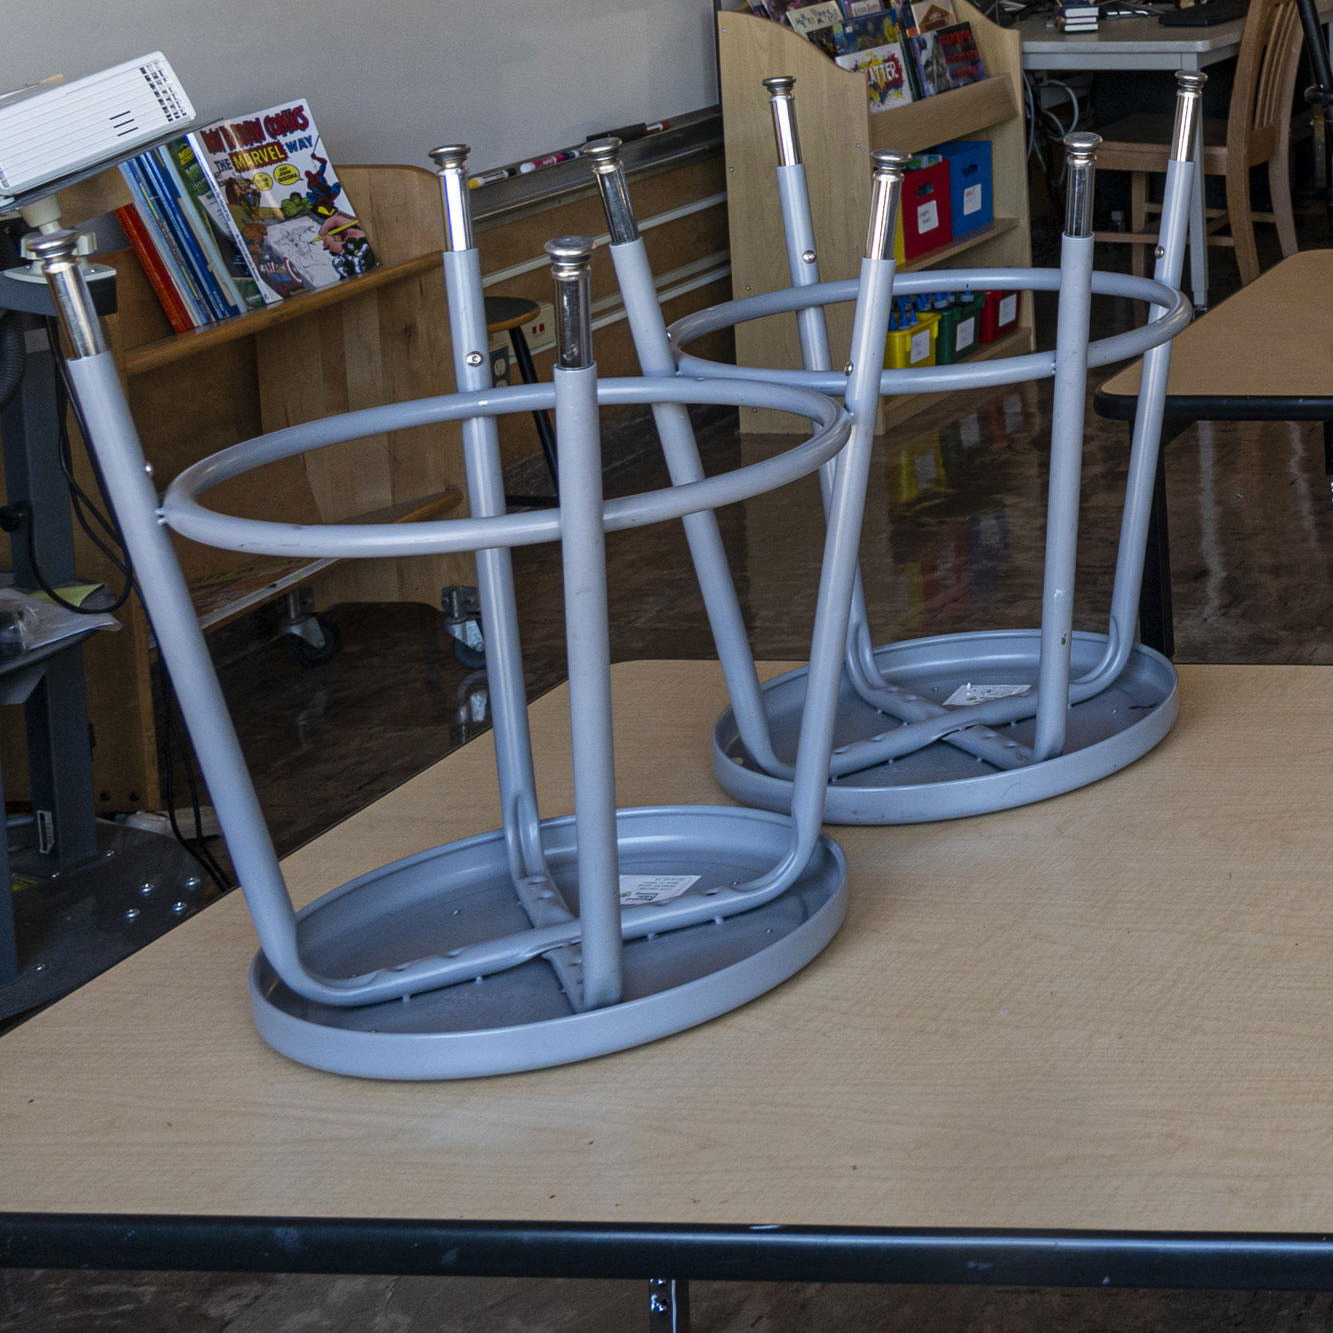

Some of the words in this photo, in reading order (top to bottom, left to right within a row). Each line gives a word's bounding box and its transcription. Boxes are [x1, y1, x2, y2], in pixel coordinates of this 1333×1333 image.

[263, 105, 309, 140] COMICS
[214, 159, 233, 173] THE
[232, 145, 285, 170] MARVEL
[285, 135, 313, 154] WAY
